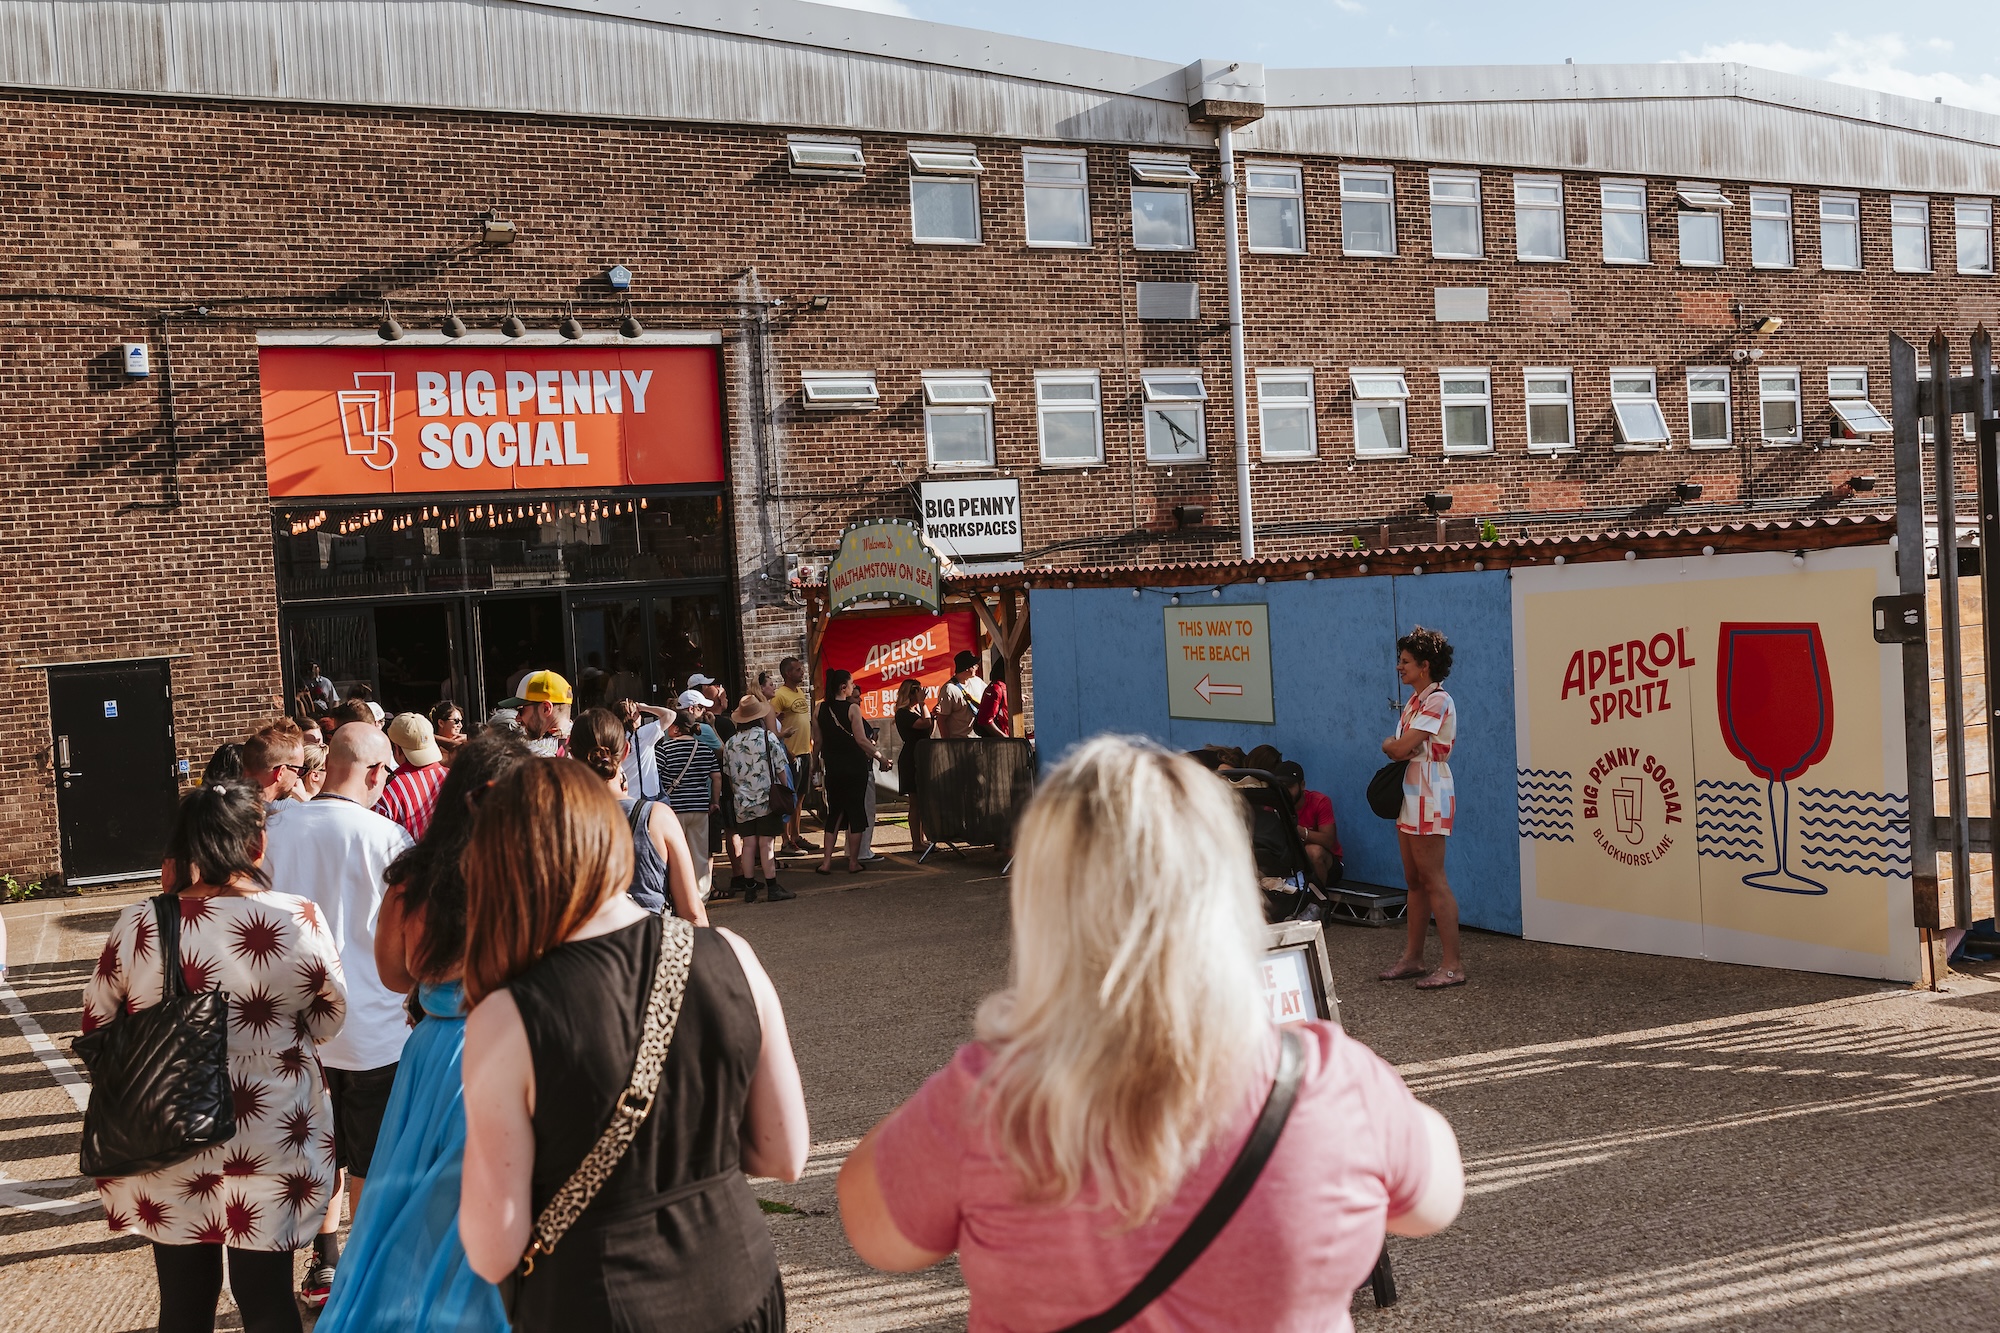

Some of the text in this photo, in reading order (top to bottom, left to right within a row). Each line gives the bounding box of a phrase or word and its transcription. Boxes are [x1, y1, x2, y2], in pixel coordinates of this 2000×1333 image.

[417, 370, 653, 417] BIG PENNY
[420, 421, 589, 470] SOCIAL
[925, 496, 1016, 518] BIG PENNY
[862, 536, 886, 552] Welcome
[927, 521, 1017, 539] WORKSPACES
[832, 562, 933, 592] WALTHAMSTOW ON SEA
[1178, 620, 1253, 636] THIS WAY TO
[862, 631, 937, 672] APEROL
[1183, 645, 1250, 662] THE BEACH
[1561, 627, 1696, 701] APEROL
[881, 655, 925, 681] SPRITZ
[1589, 678, 1672, 726] SPRITZ
[1583, 747, 1682, 825] BIG PENNY SOCIAL
[1592, 828, 1674, 867] BLACKHORSE LANE
[1280, 989, 1301, 1017] AT
